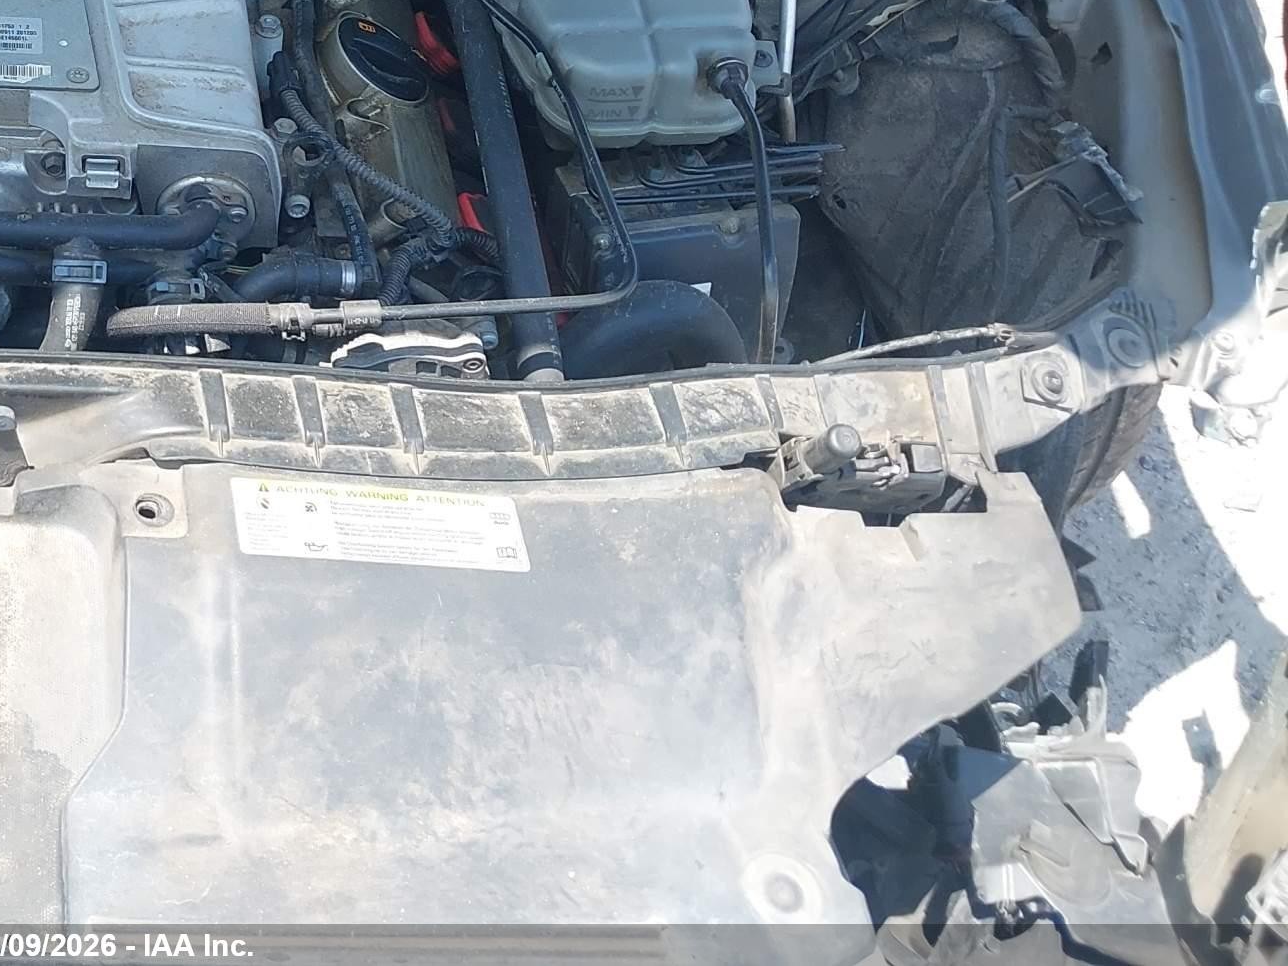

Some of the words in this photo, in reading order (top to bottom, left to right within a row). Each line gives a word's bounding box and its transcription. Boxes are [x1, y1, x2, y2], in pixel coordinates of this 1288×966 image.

[590, 87, 629, 98] MAX
[586, 109, 622, 118] MIN
[276, 486, 338, 497] ACHTUNG
[345, 490, 409, 502] WARNING
[416, 495, 486, 507] ATTENTION
